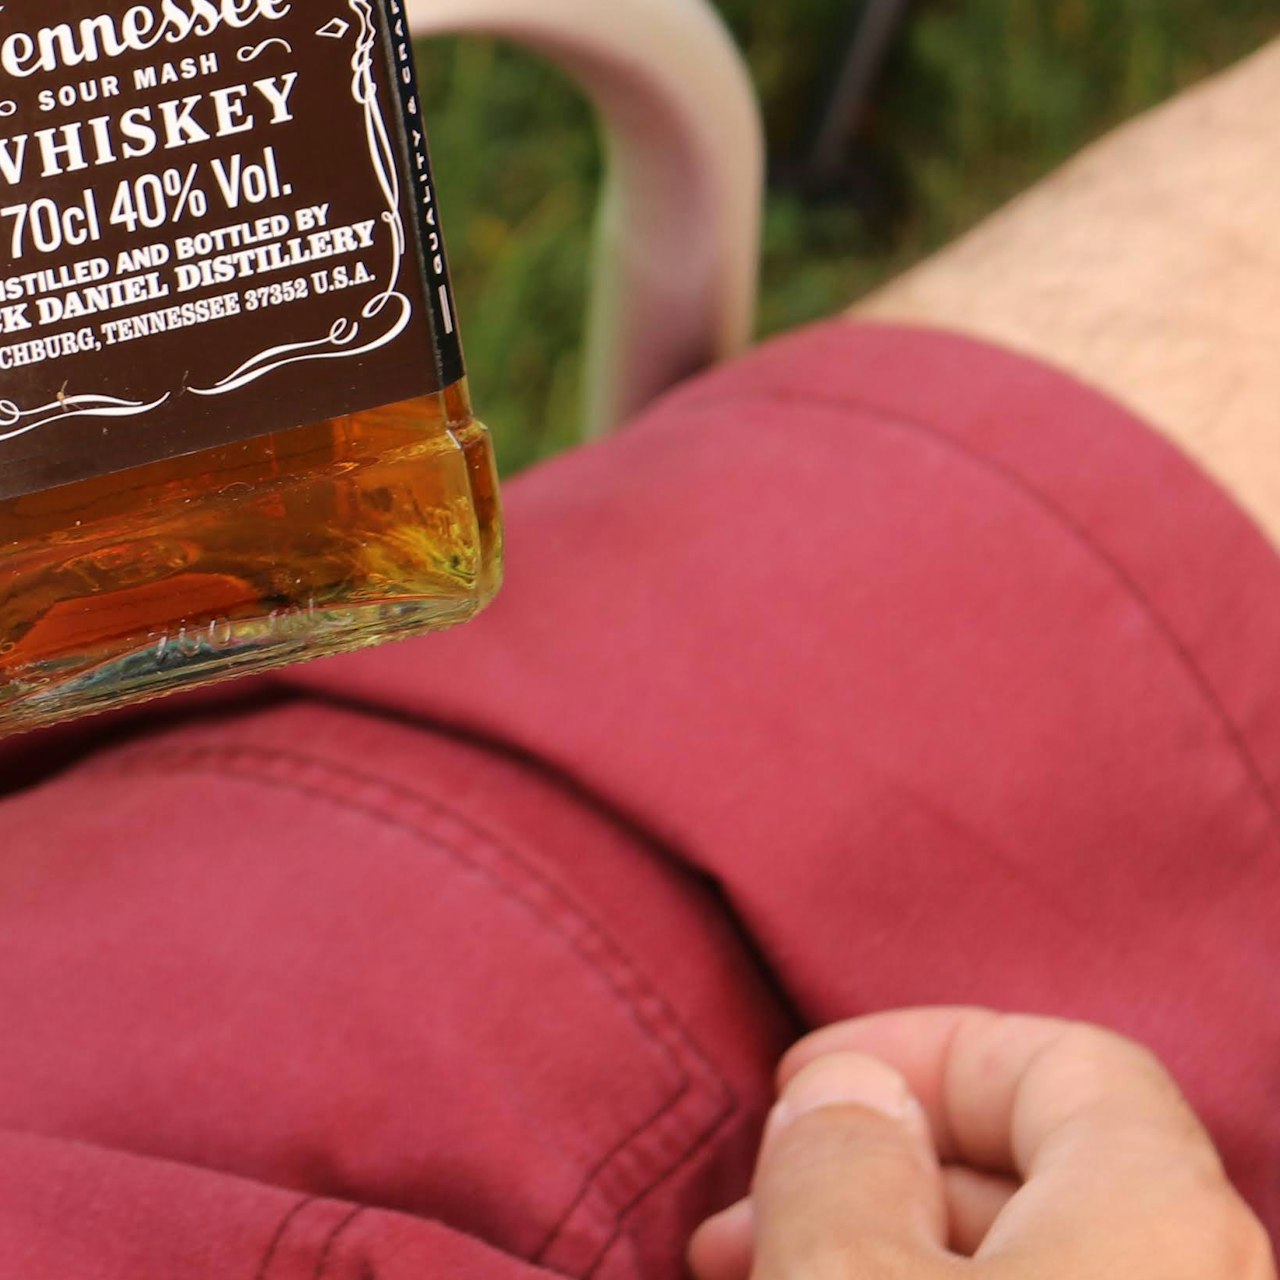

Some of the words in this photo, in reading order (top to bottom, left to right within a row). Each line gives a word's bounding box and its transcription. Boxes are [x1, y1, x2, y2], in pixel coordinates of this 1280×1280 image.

[38, 76, 120, 112] SOUR
[133, 52, 219, 91] MASH
[0, 189, 101, 260] 70cl
[109, 163, 207, 233] 40%
[211, 146, 293, 210] Vol.
[116, 243, 170, 276] AND
[176, 213, 291, 260] BOTTLED
[296, 203, 330, 231] BY
[412, 128, 443, 275] QUALITY
[37, 282, 169, 326] DANIEL
[174, 219, 376, 293] DISTILLERY
[104, 295, 241, 345] TENNESSEE
[244, 275, 309, 311] 37352
[311, 261, 377, 295] U.S.A.
